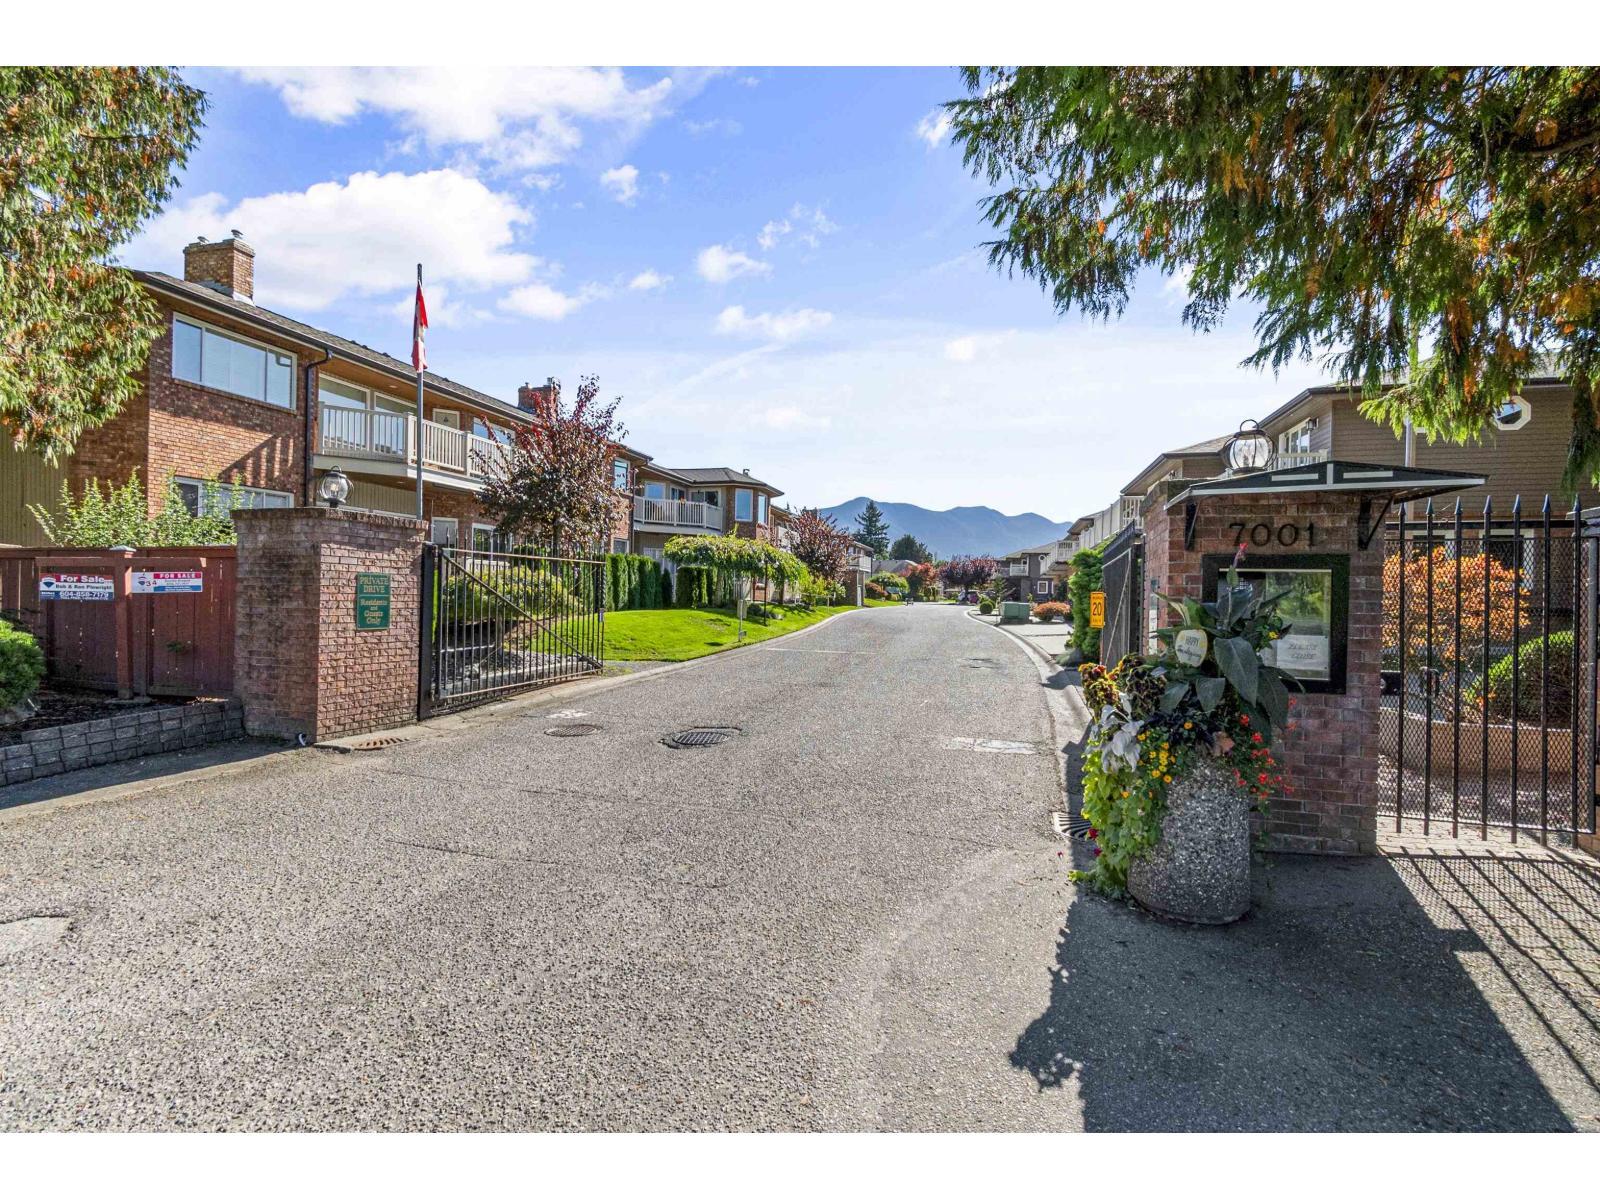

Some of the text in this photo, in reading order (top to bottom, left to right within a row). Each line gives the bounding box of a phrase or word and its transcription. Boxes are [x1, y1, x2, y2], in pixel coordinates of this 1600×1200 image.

[1229, 522, 1315, 547] 7001
[60, 575, 105, 583] For Sale
[360, 576, 389, 585] PRIVATE
[363, 585, 386, 593] DRIVE
[1092, 602, 1102, 616] 20
[366, 617, 382, 626] Only
